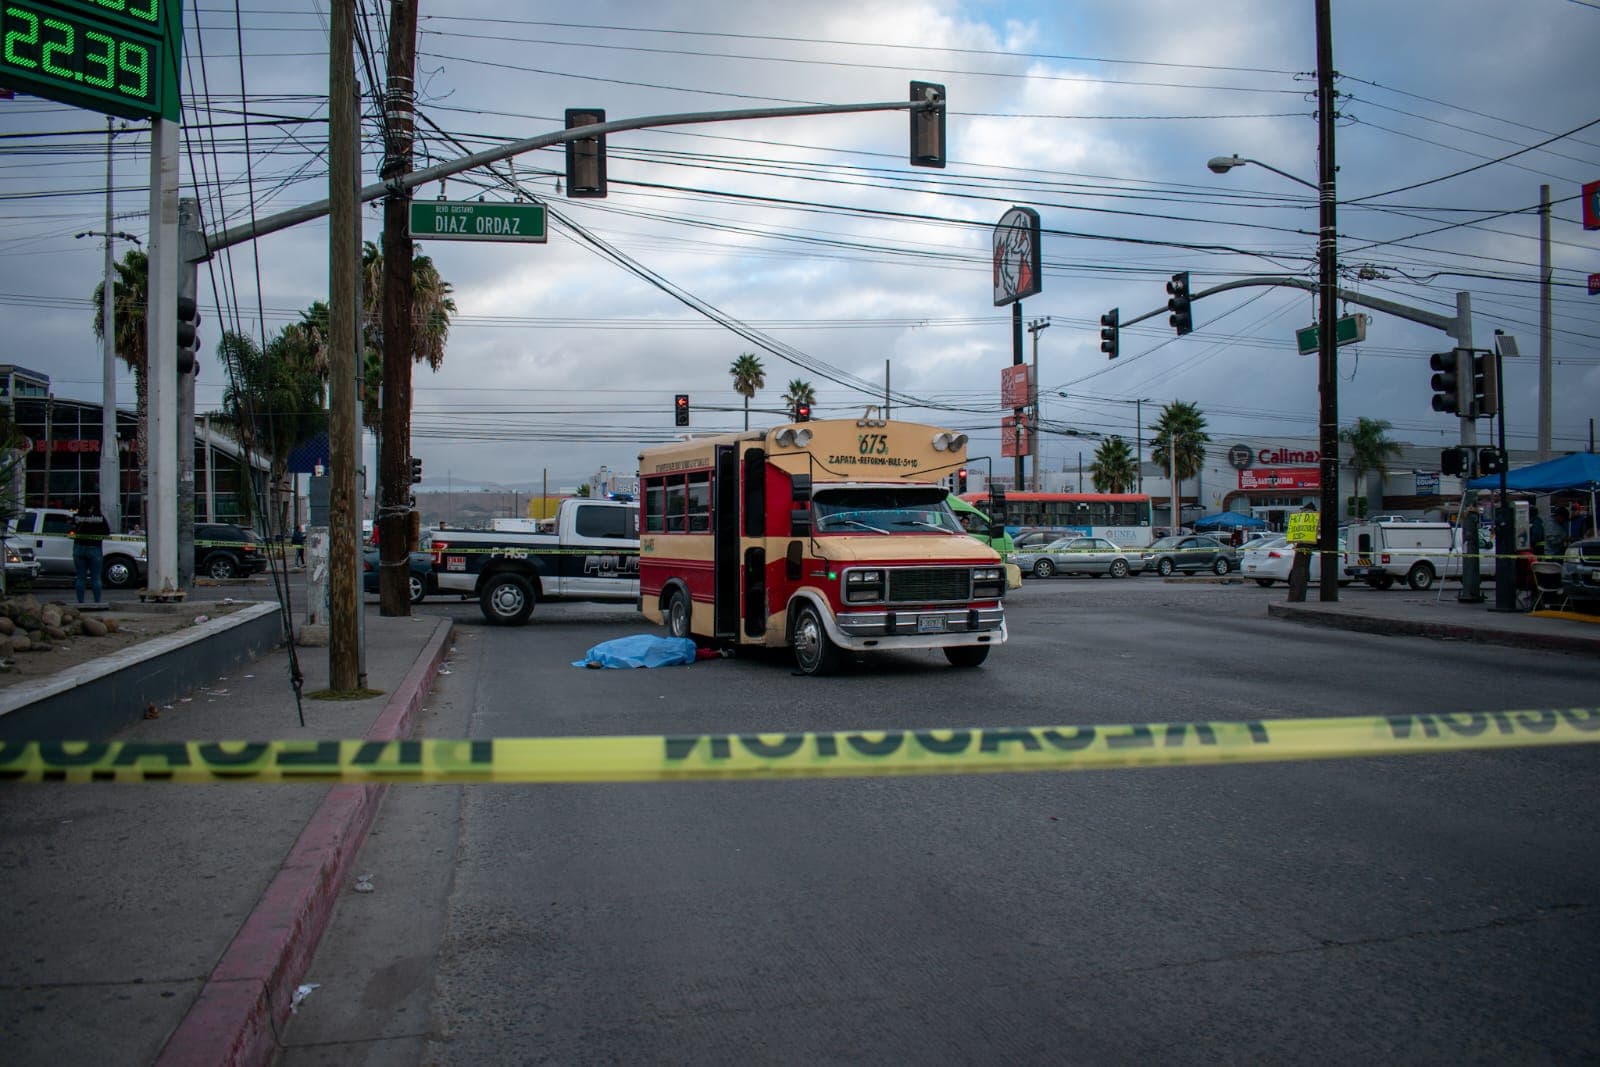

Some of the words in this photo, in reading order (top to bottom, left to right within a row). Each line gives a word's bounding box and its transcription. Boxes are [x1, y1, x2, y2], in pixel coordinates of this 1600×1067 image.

[5, 7, 148, 98] 22.39
[435, 216, 467, 232] DIAZ
[476, 217, 520, 234] ORDAZ
[859, 434, 888, 454] 675
[1258, 448, 1320, 464] Calimax
